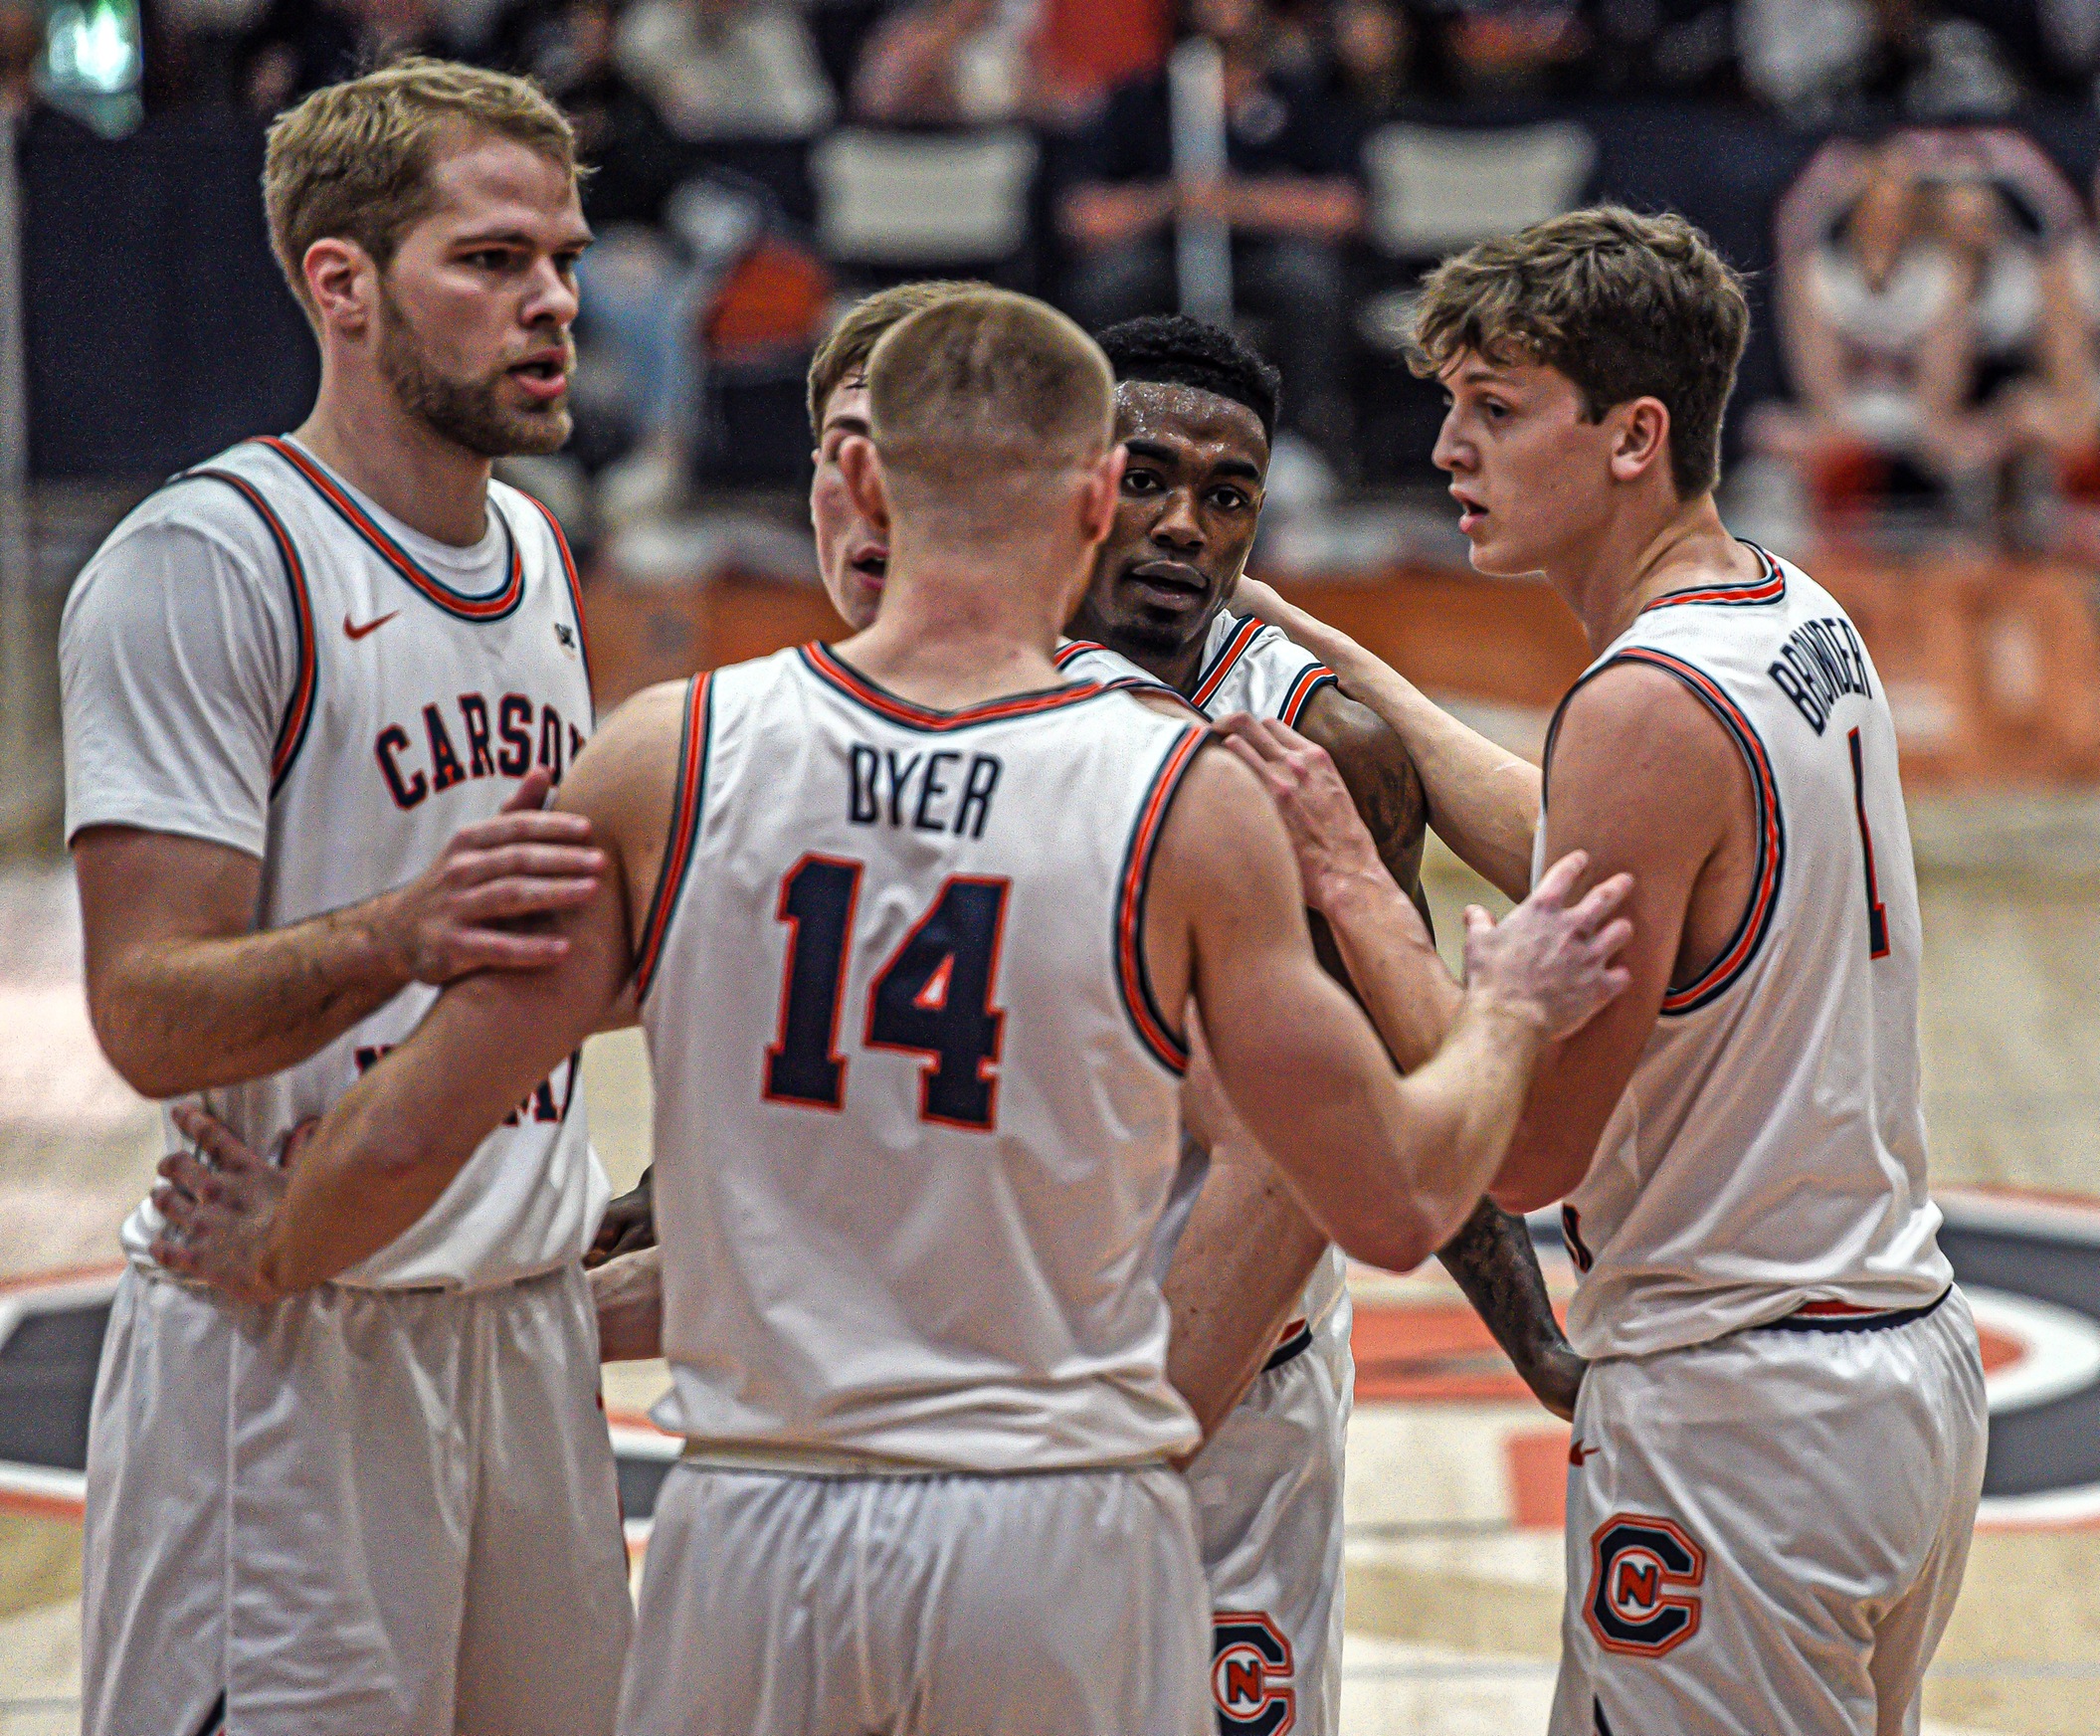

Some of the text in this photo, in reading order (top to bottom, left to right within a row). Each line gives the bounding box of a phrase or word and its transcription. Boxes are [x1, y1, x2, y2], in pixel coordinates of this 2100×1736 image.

[848, 741, 1003, 840] DYER
[1847, 725, 1890, 961] 1
[762, 851, 1012, 1133] 14
[1617, 1560, 1658, 1608] N
[1226, 1659, 1263, 1703] N
